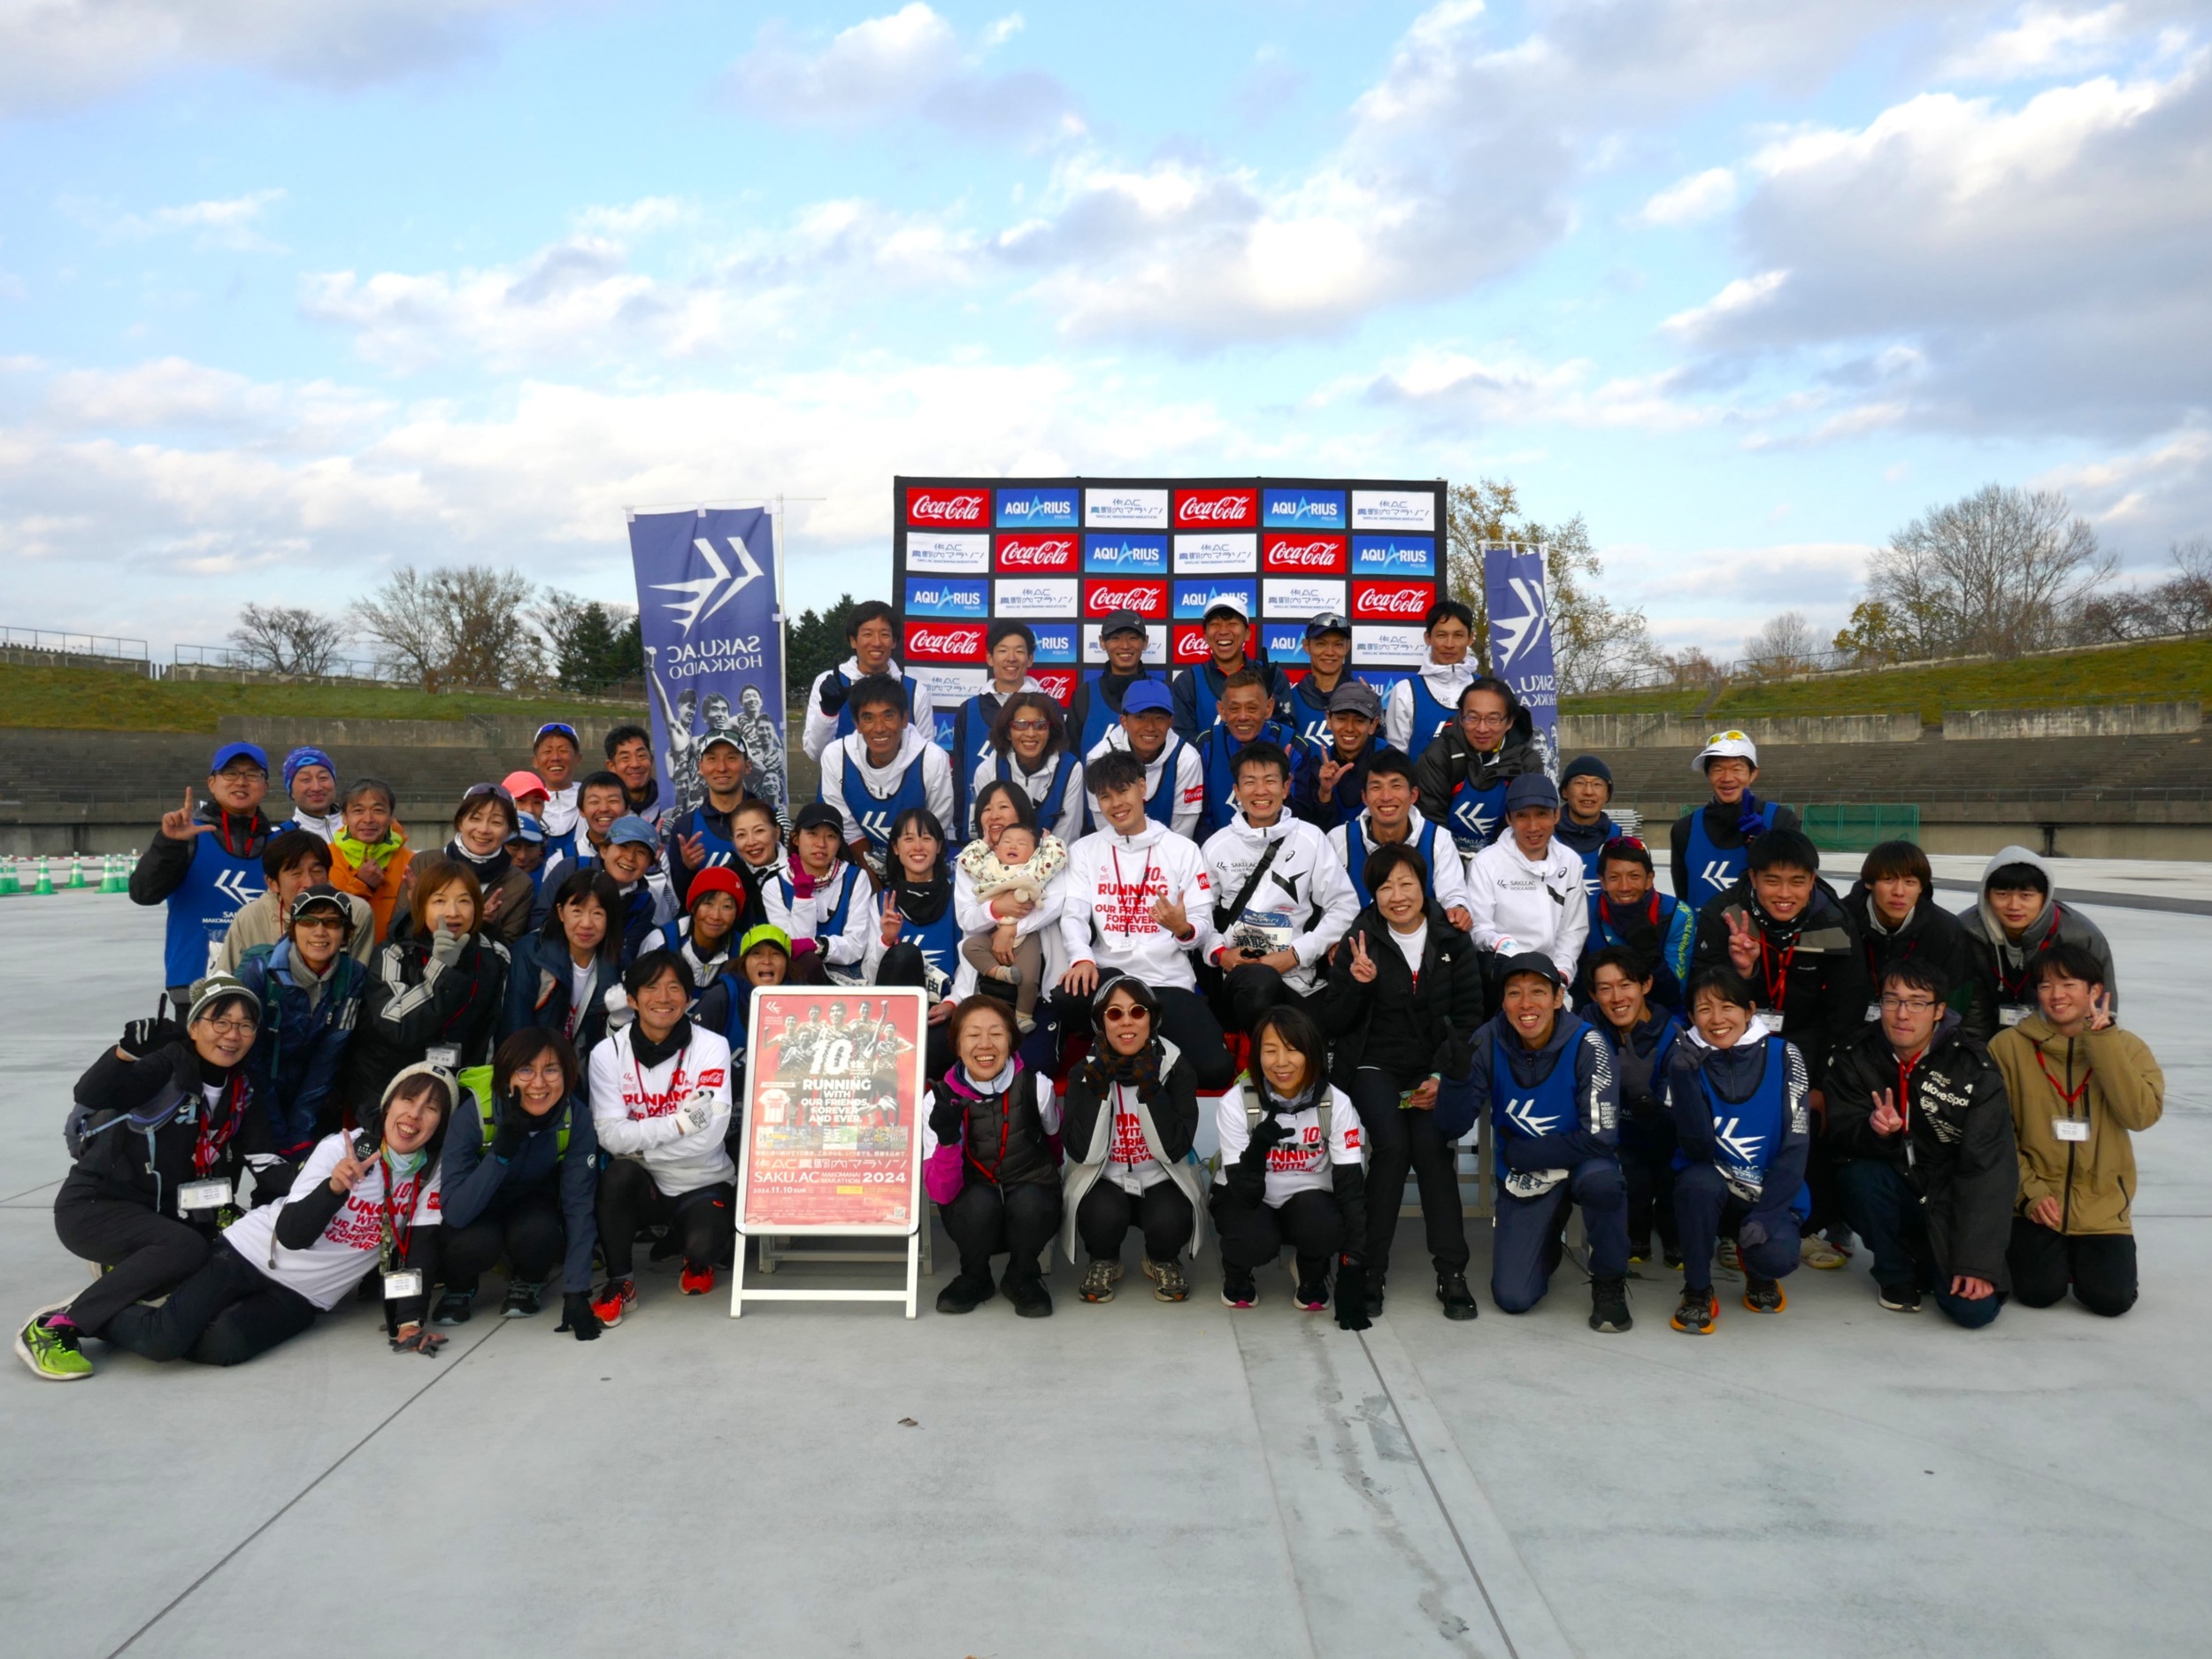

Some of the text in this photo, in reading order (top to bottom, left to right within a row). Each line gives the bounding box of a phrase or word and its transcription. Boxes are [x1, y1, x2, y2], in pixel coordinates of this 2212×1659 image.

[912, 495, 983, 520] Coca-Cola
[1004, 495, 1071, 519] AQUARIUS
[1179, 496, 1249, 521] Coca-Cola
[1271, 496, 1337, 520] AQUARIUS
[1001, 541, 1071, 565] Coca-Cola
[1094, 541, 1159, 565] AQUARIUS
[1269, 541, 1339, 565] Coca-Cola
[1361, 543, 1426, 567] AQUARIUS
[914, 586, 980, 610] AQUARIUS
[1090, 587, 1160, 611] Coca-Cola
[1357, 588, 1428, 612] Coca-Cola
[910, 630, 980, 655] Coca-Cola
[1098, 883, 1168, 895] RUNNING
[1095, 904, 1116, 913] OUR
[803, 1079, 871, 1090] RUNNING
[1921, 1081, 1970, 1107] MoveSpor
[1302, 1126, 1320, 1143] 10
[754, 1171, 906, 1183] SAKU.AC 2024
[1271, 1161, 1306, 1170] WITH
[332, 1217, 382, 1233] UR FRIEN
[356, 1214, 382, 1225] WIT
[349, 1241, 375, 1250] EVE
